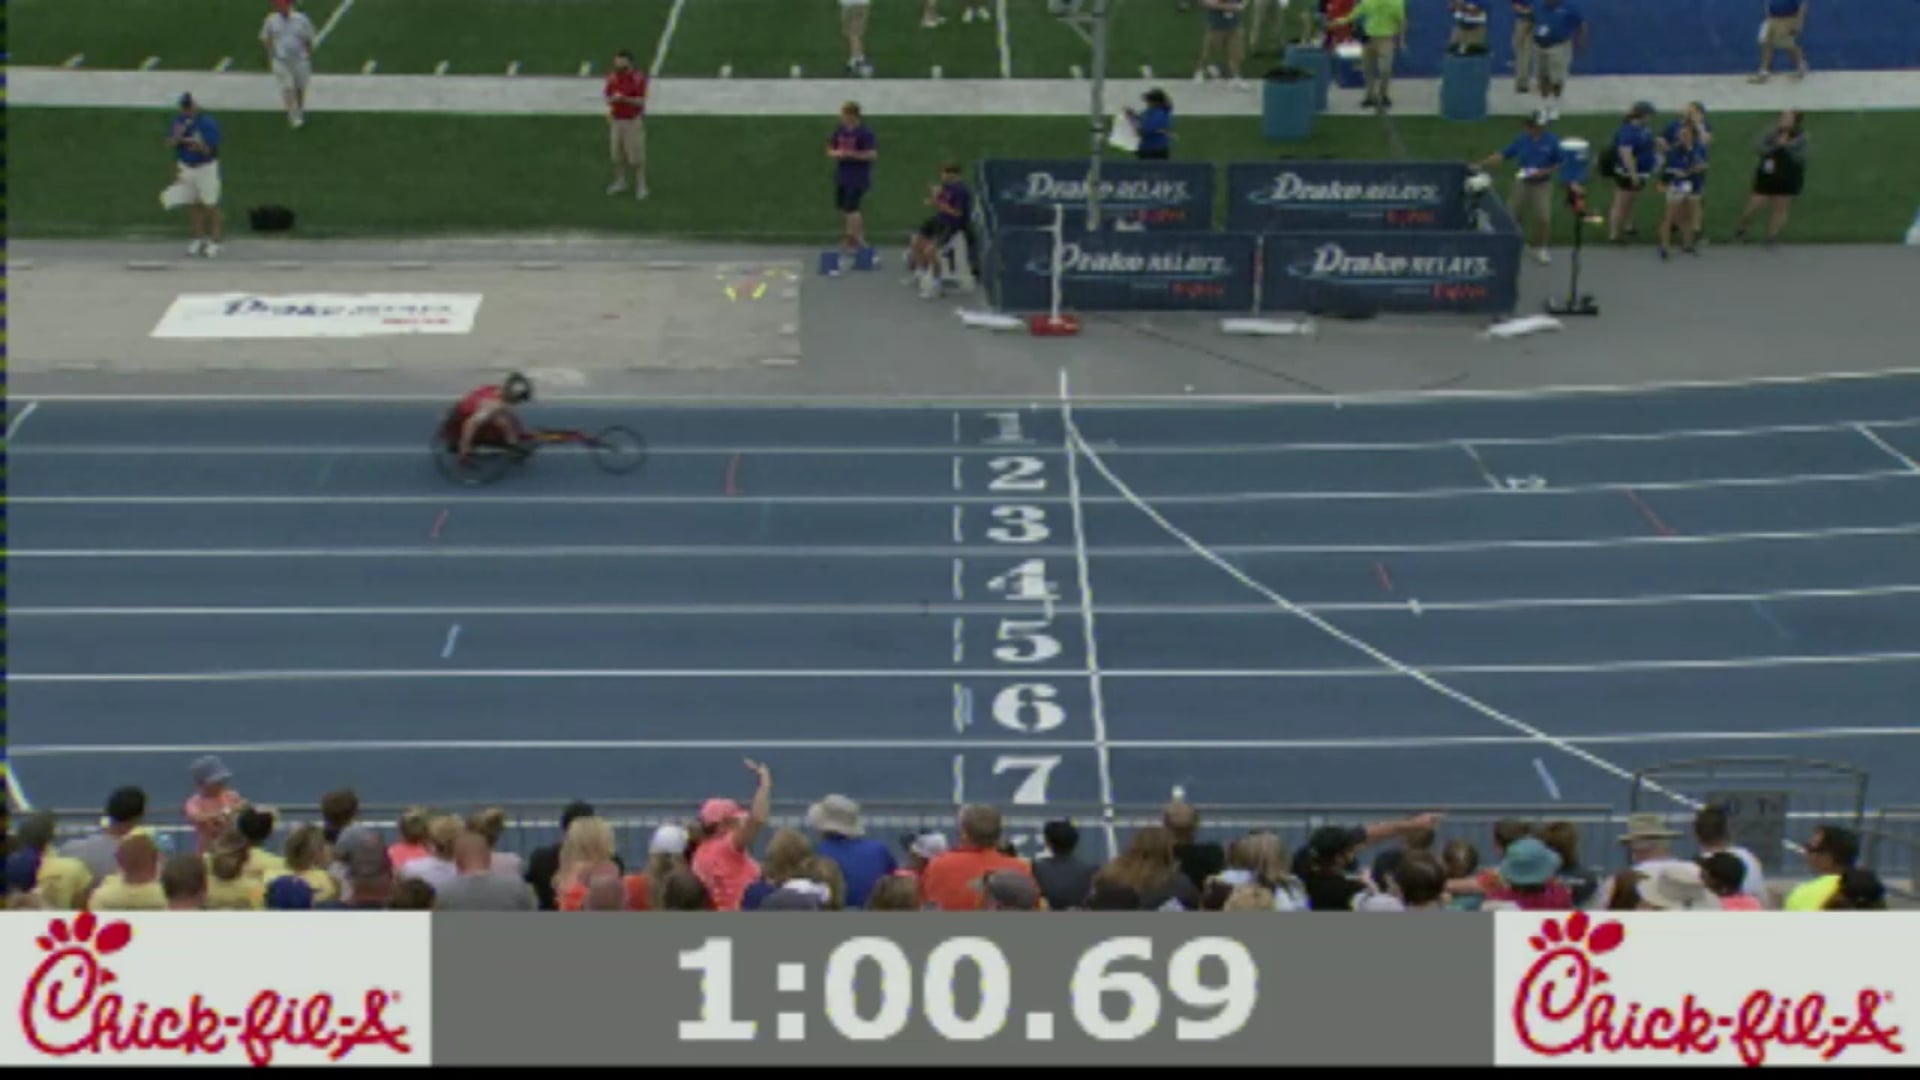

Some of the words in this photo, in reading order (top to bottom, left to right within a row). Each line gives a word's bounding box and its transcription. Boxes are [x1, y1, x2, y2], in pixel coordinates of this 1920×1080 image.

[1027, 172, 1114, 200] Drae
[1271, 172, 1363, 200] Drake
[1312, 243, 1408, 273] Drake
[987, 455, 1046, 490] 2
[986, 504, 1050, 543] 3
[986, 559, 1061, 599] 4
[993, 603, 1061, 663] 5
[992, 682, 1065, 733] 6
[991, 754, 1062, 805] 7
